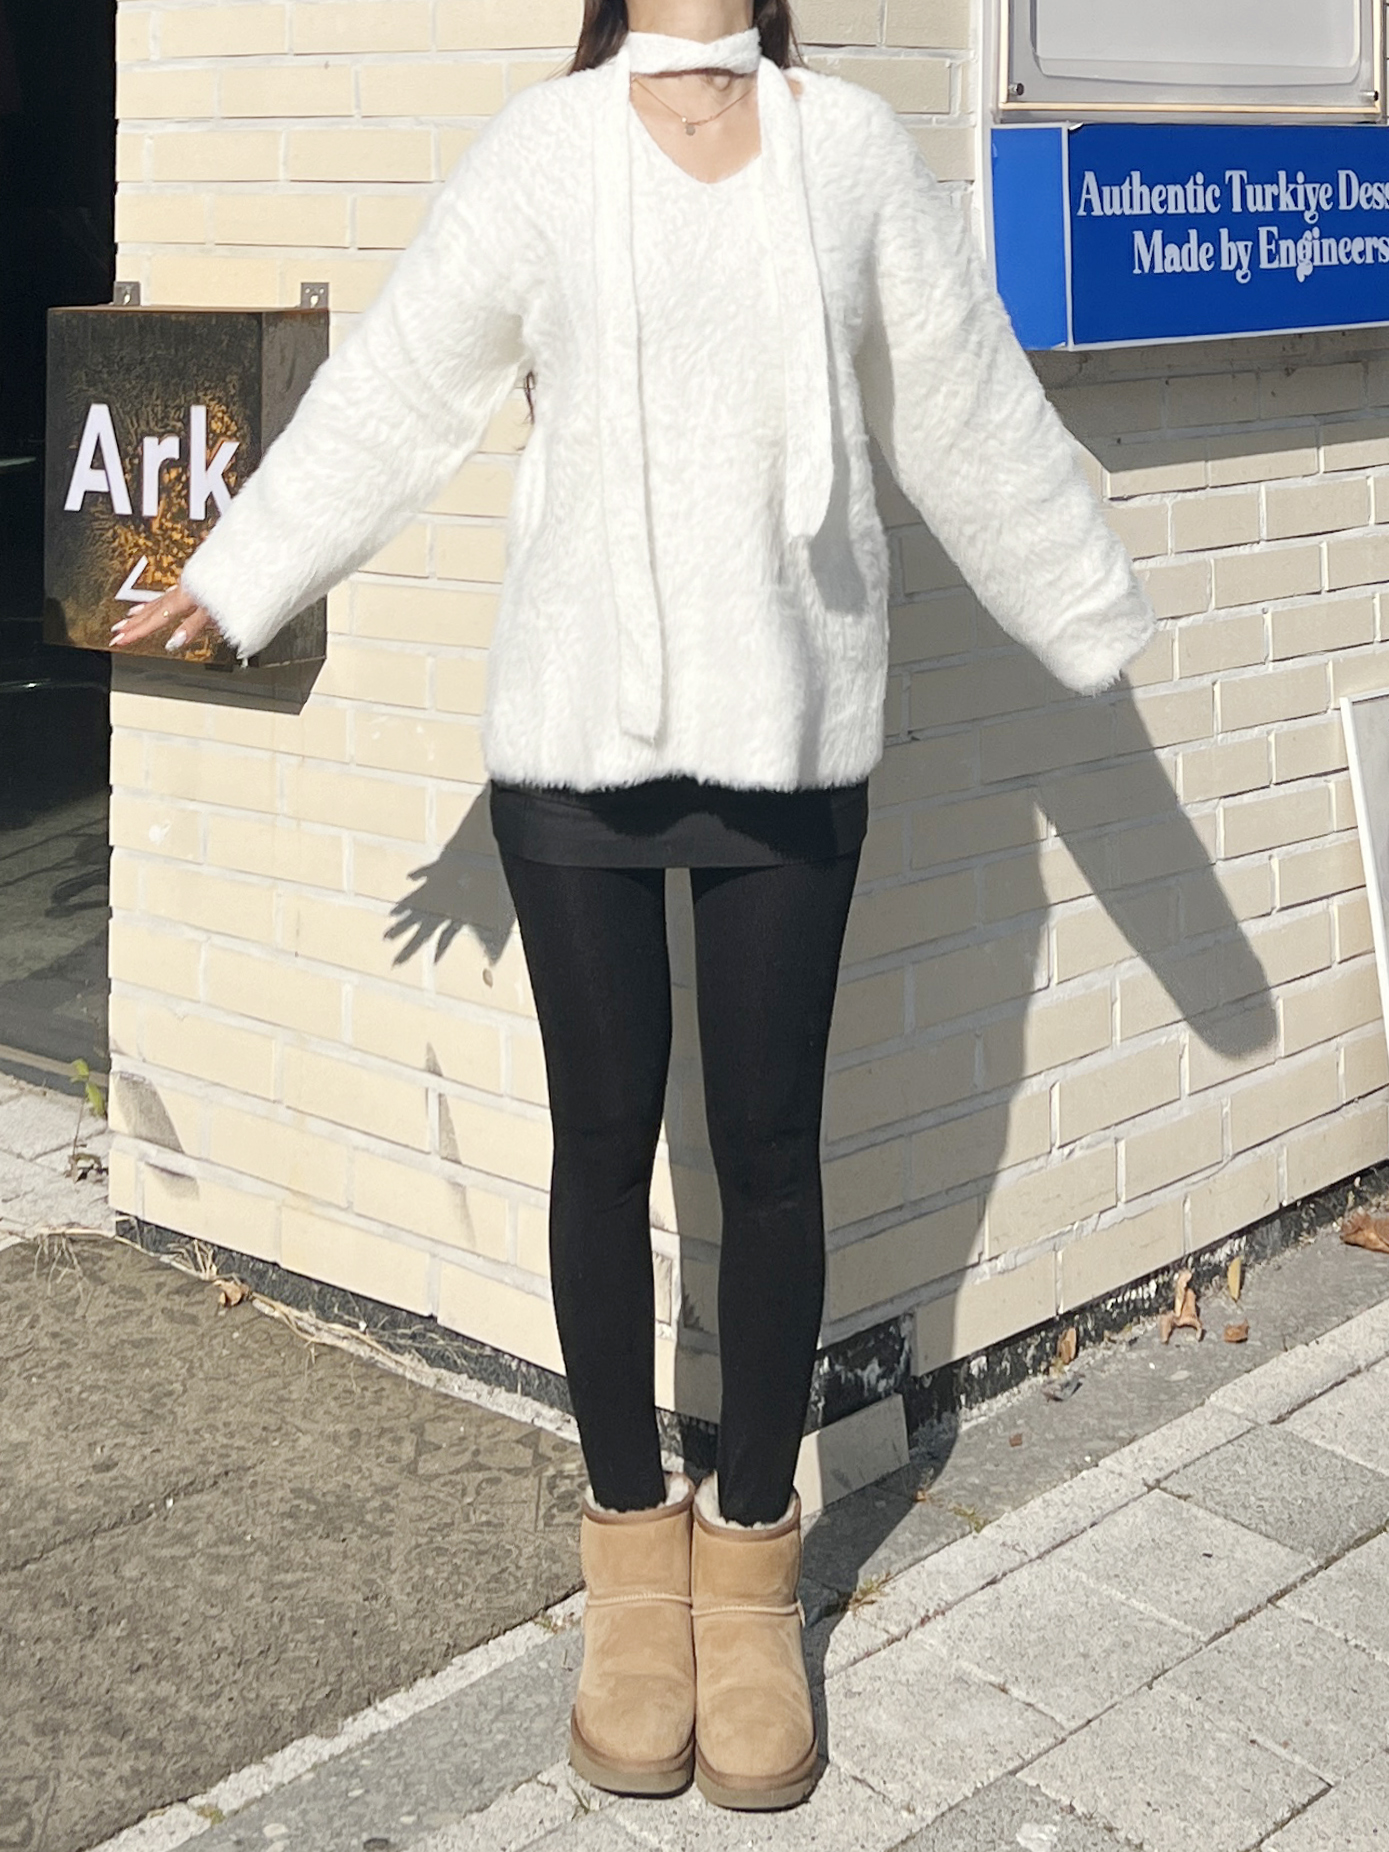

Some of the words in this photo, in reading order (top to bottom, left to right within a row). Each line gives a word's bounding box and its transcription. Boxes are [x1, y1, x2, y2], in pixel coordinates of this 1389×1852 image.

[1077, 170, 1221, 216] Authentic
[1225, 170, 1334, 224] Turkiye
[1132, 229, 1214, 275] Made
[1219, 228, 1253, 284] by
[1258, 226, 1389, 283] Engineers
[64, 403, 240, 521] Ark
